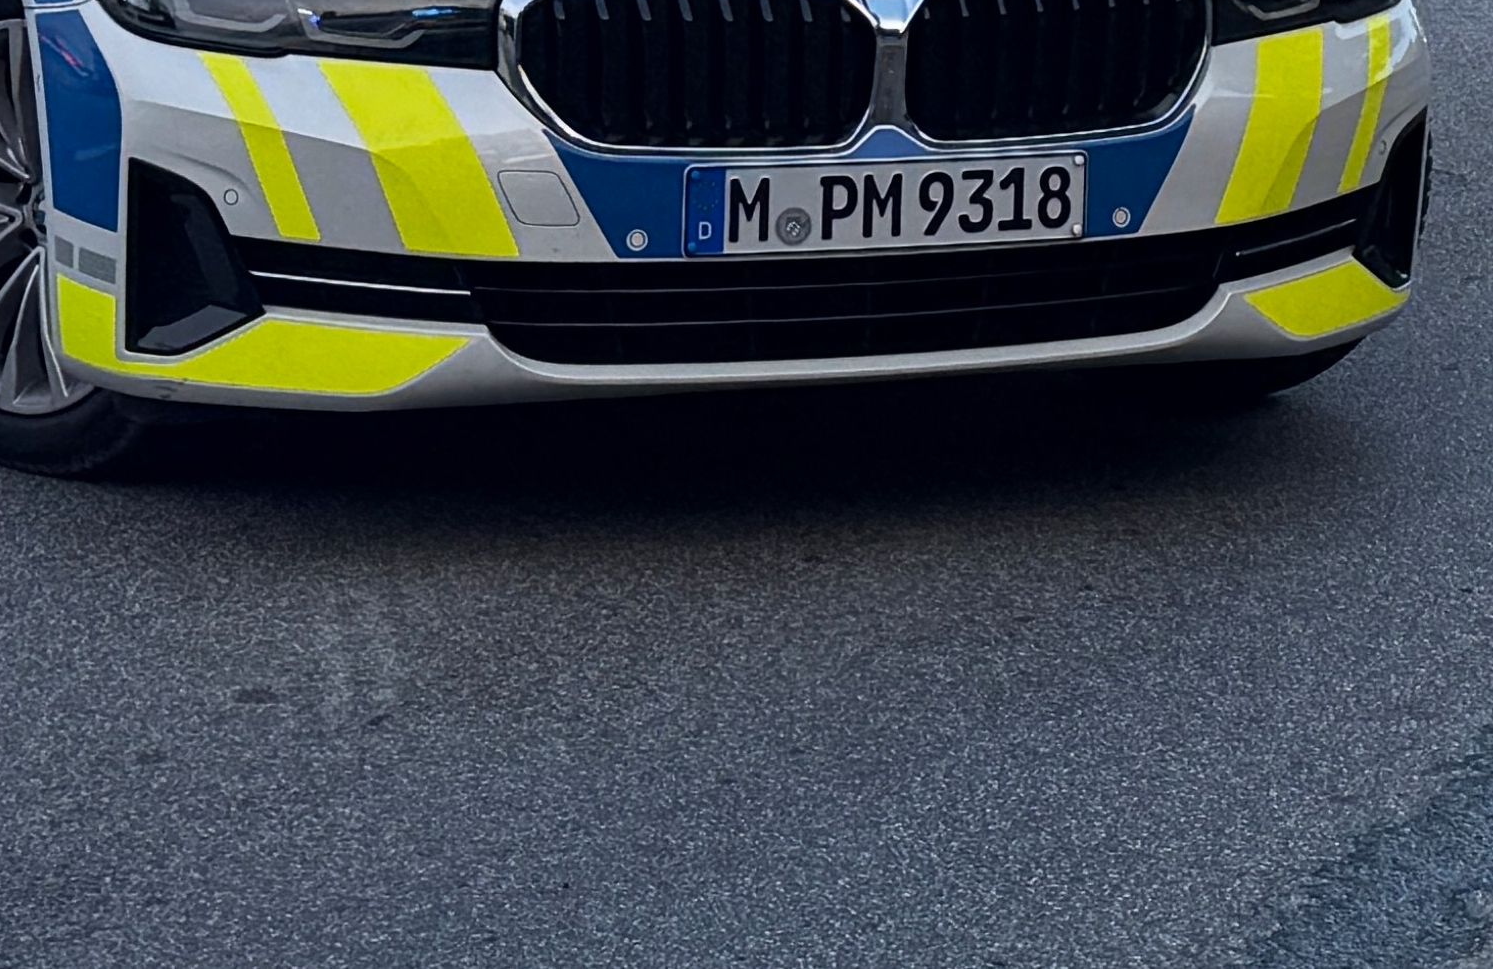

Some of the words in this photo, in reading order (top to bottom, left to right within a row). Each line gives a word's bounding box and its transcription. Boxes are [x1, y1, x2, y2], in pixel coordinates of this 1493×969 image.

[728, 177, 770, 243] M
[820, 173, 903, 240] PM
[918, 166, 1072, 236] 9318
[698, 221, 712, 240] D
